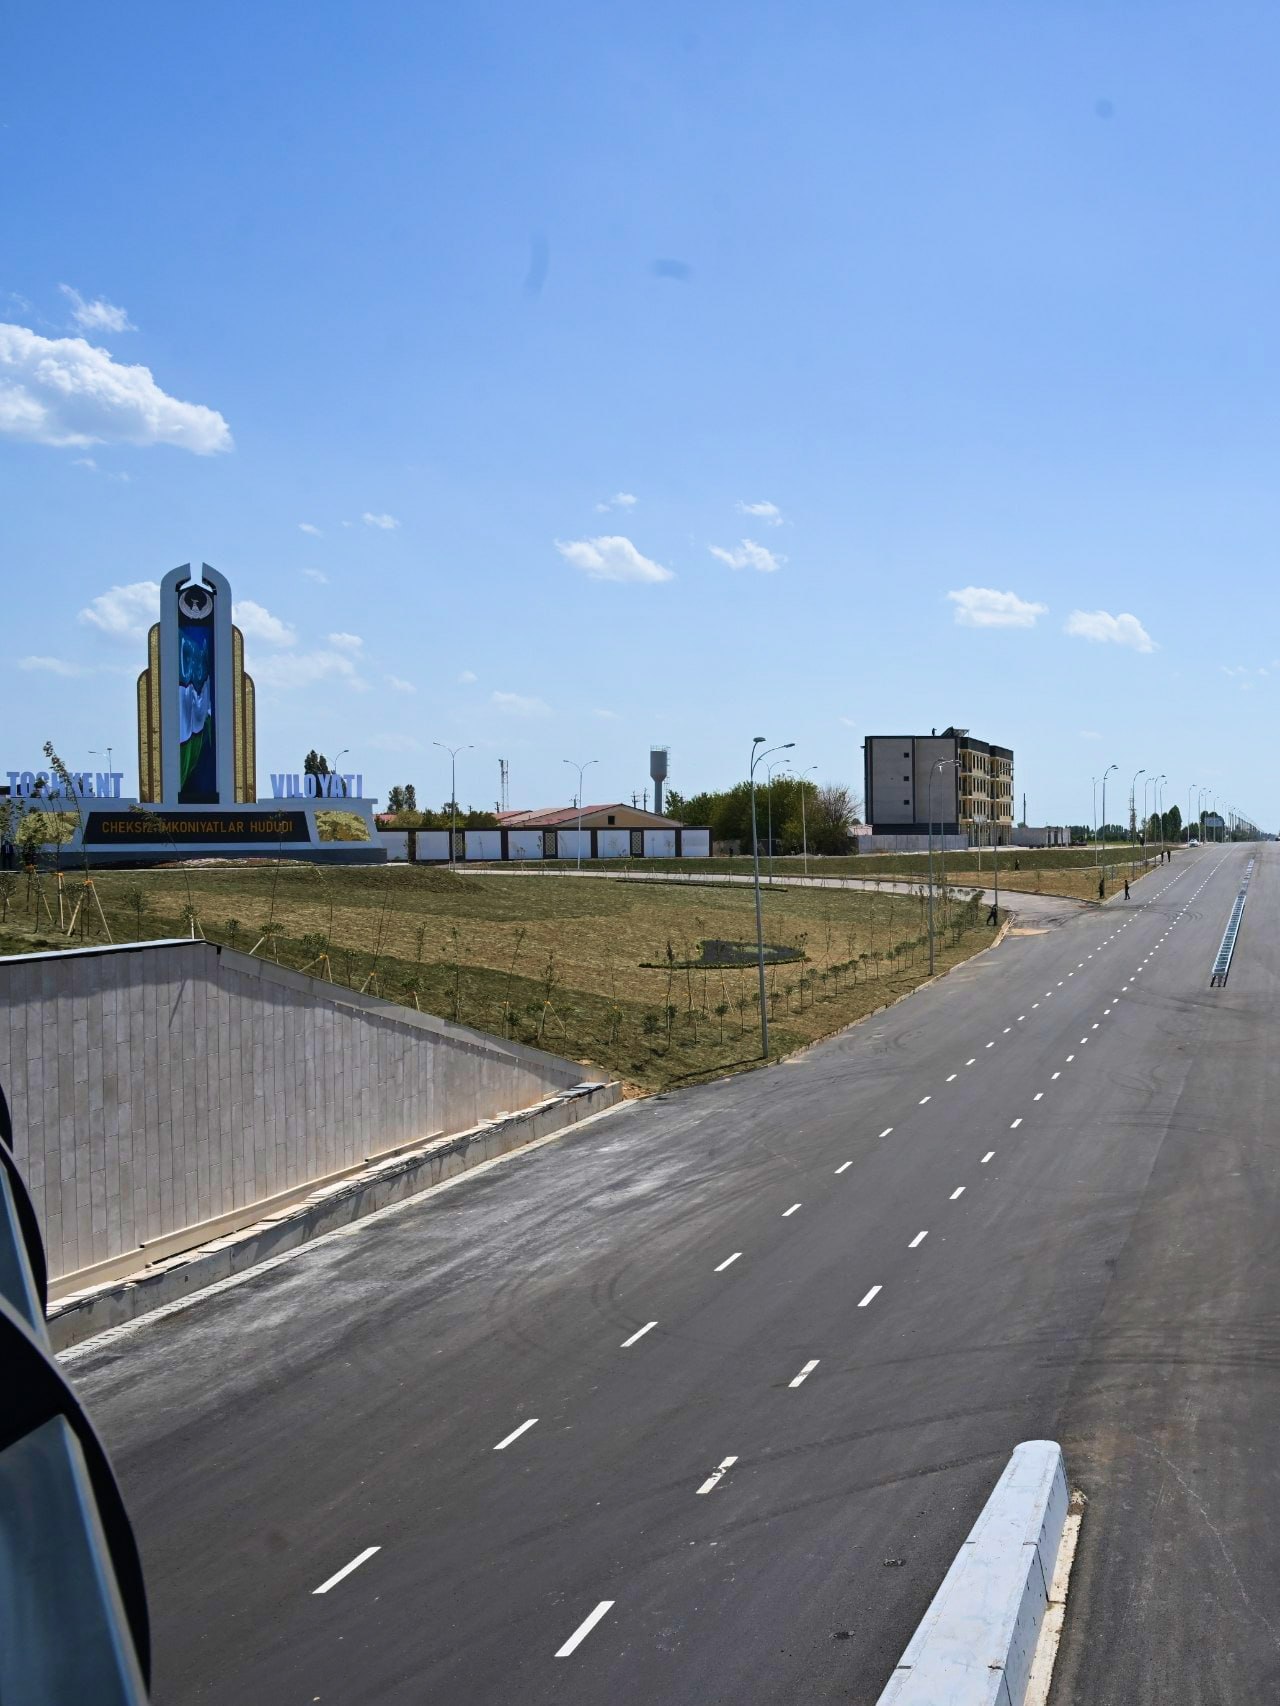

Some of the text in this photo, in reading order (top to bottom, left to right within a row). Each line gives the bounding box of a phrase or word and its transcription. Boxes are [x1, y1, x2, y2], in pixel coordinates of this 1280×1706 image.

[270, 774, 363, 799] VILOYATI
[102, 821, 154, 833] CHEKSIZ
[250, 821, 293, 833] HUDUDI
